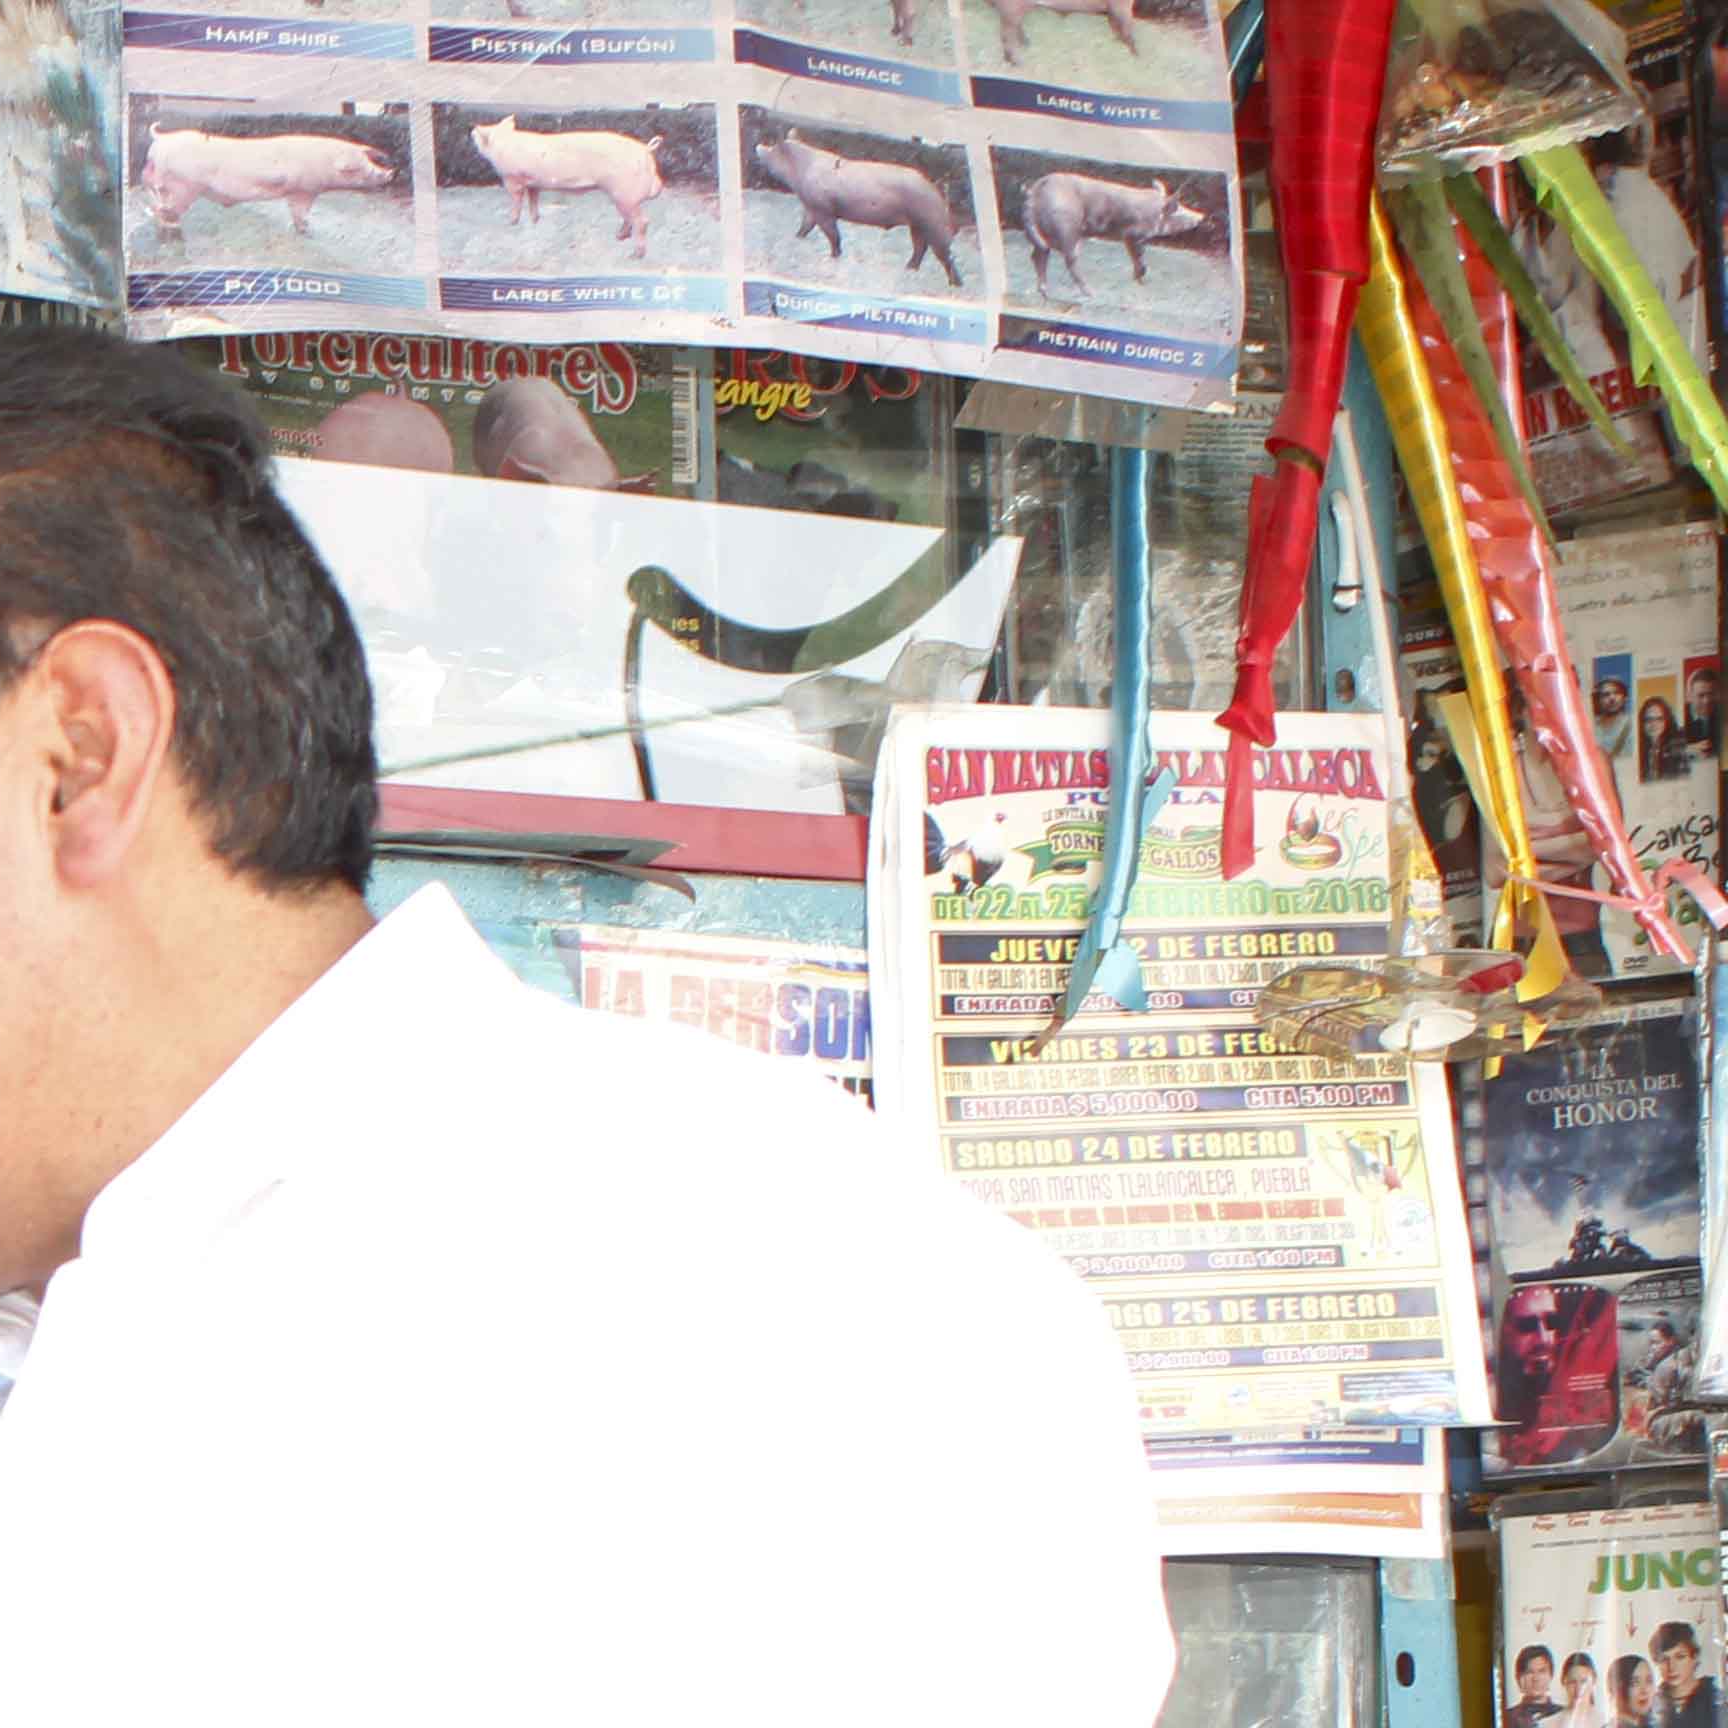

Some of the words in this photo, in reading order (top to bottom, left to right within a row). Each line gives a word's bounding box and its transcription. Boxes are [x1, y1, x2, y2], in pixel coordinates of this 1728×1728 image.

[1037, 95, 1095, 114] LARGE
[1102, 104, 1162, 121] WHITE
[573, 286, 642, 301] WHITE
[1039, 330, 1118, 353] PIETRAIN
[1192, 351, 1204, 367] 2
[926, 747, 987, 803] SAN
[991, 749, 1109, 796] MATIAS
[976, 885, 1016, 918] 22
[1048, 884, 1087, 917] 25
[1309, 880, 1387, 914] 2018
[990, 940, 1081, 964] JUEVE
[1159, 936, 1195, 958] DE
[1206, 931, 1335, 956] FEBRERO
[1128, 1033, 1167, 1059] 23
[1178, 1031, 1214, 1056] DE
[1245, 1090, 1299, 1109] CITA
[1357, 1085, 1392, 1104] PM
[1526, 1078, 1641, 1106] CONQUISTA
[1553, 1096, 1659, 1130] HONOR
[956, 1137, 1073, 1168] SABADO
[1082, 1137, 1120, 1162] 24
[1129, 1135, 1164, 1161] DE
[1173, 1131, 1295, 1158] FEBRERO
[1172, 1300, 1211, 1324] 25
[1221, 1299, 1259, 1322] DE
[1267, 1292, 1397, 1319] FEBRERO
